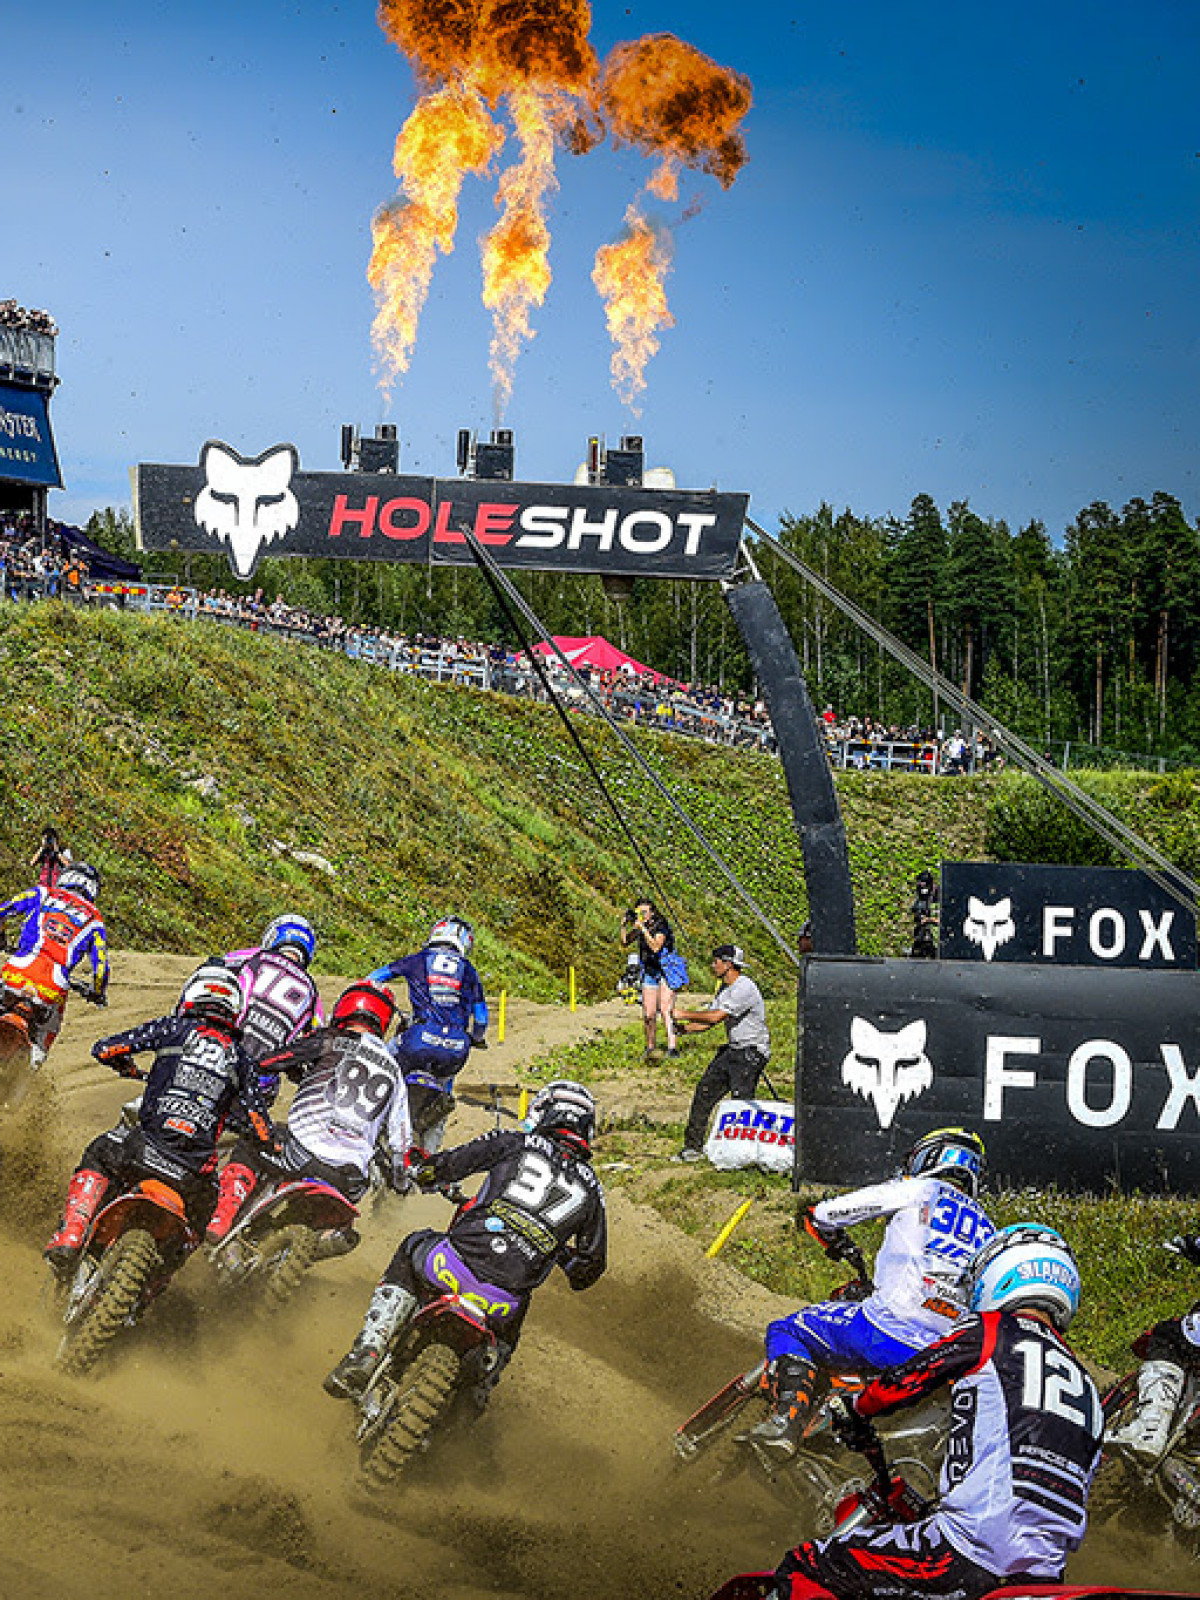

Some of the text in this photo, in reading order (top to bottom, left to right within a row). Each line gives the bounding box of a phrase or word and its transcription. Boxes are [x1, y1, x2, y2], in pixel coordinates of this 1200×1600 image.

[328, 493, 716, 556] HOLESHOT
[1042, 905, 1175, 961] FOX
[251, 964, 310, 1020] 10
[432, 953, 458, 975] 6
[983, 1033, 1200, 1131] FOX
[715, 1126, 796, 1148] UROP
[504, 1152, 587, 1227] 37
[1011, 1339, 1086, 1428] 12
